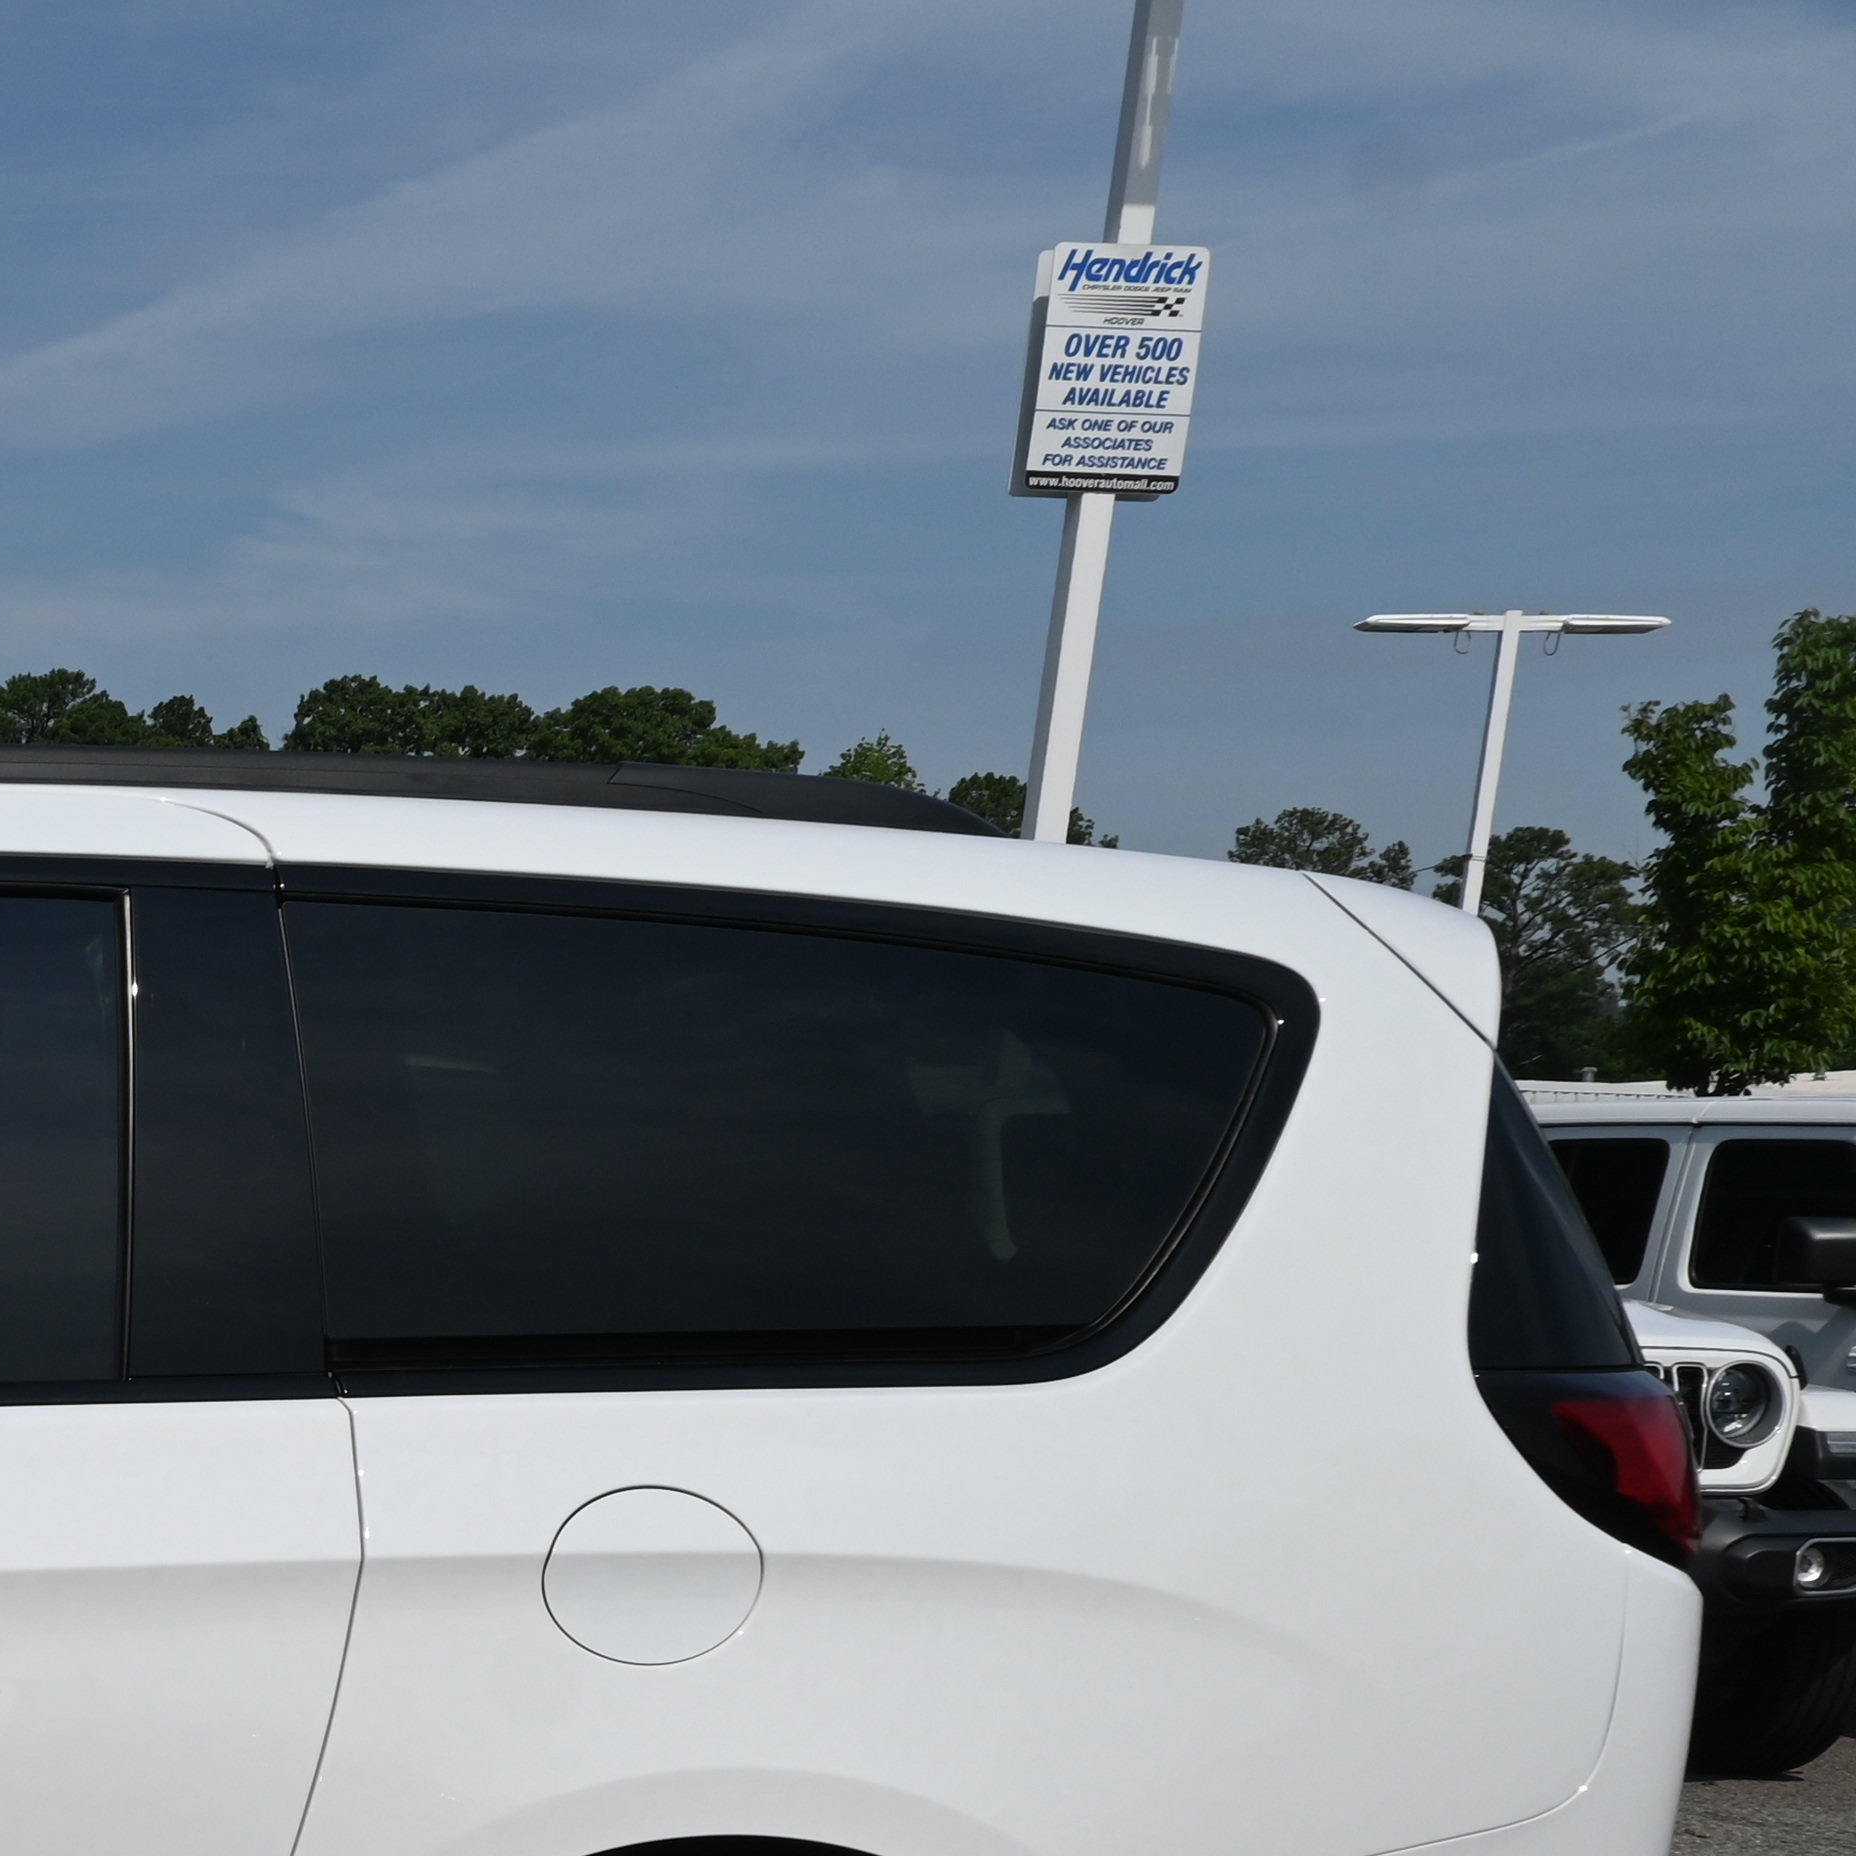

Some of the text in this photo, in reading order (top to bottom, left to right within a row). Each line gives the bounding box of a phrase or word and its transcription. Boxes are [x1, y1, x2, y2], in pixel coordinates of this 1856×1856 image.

[1058, 249, 1203, 292] Hendrick
[1103, 316, 1145, 325] HOOVER
[1064, 333, 1183, 361] OVER 500
[1048, 363, 1190, 386] NEW VEHICLES
[1062, 387, 1170, 409] AVAILABLE
[1046, 418, 1174, 433] ASK ONE OF OUR
[1061, 437, 1154, 451] ASSOCIATES
[1042, 453, 1168, 470] FOR ASSISTANCE
[1028, 475, 1175, 491] www.hooverautomall.com
